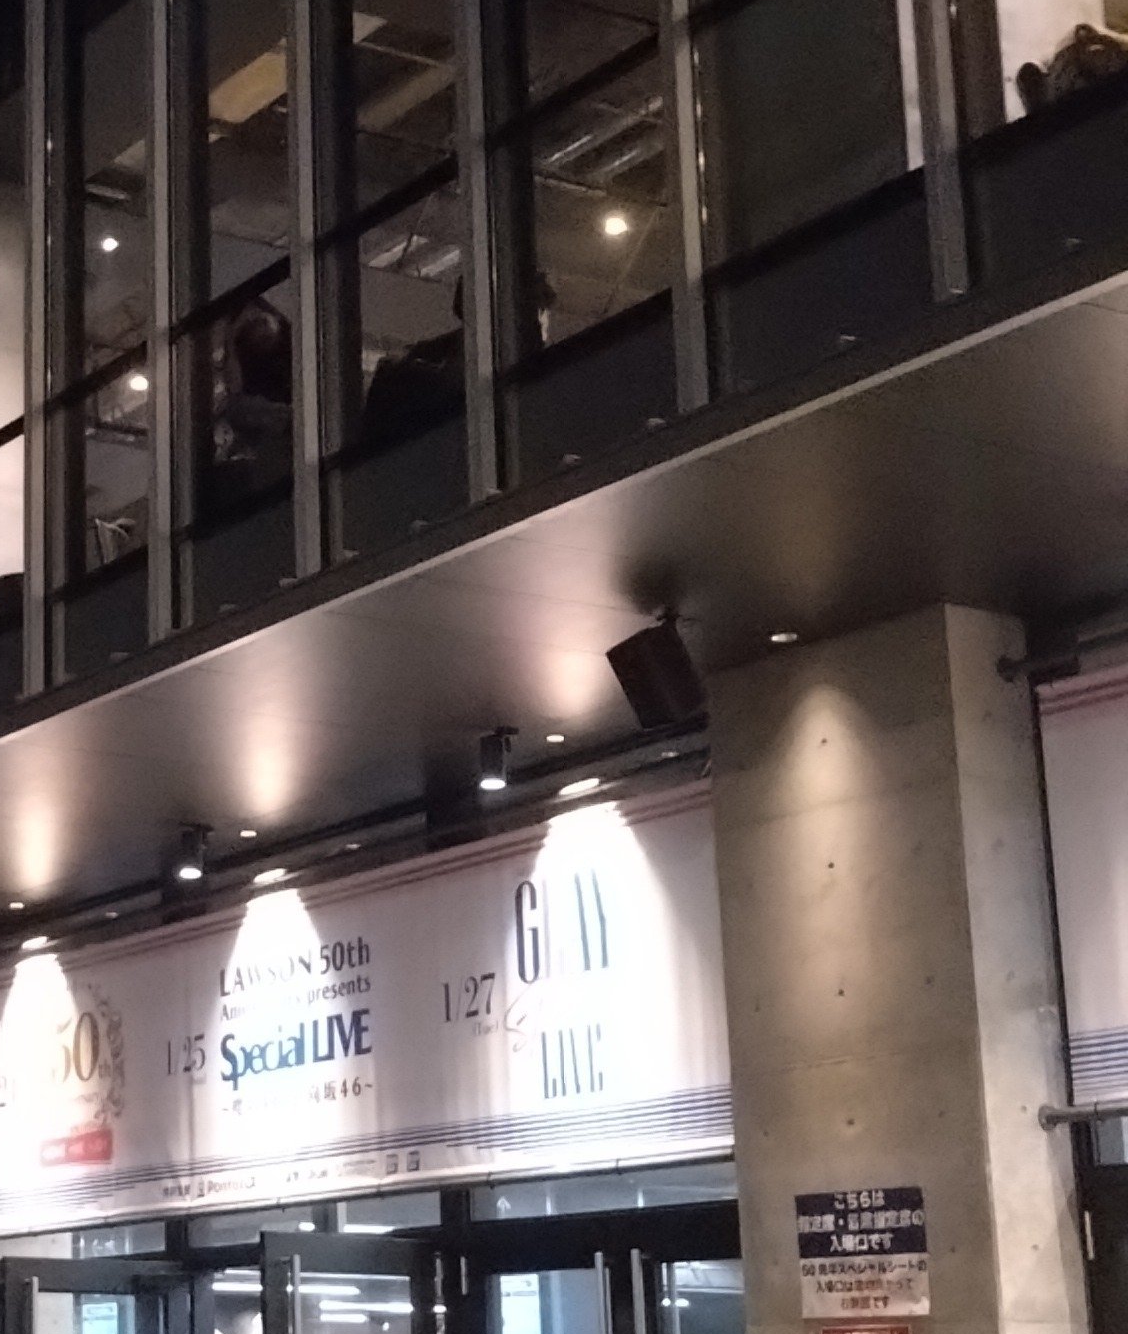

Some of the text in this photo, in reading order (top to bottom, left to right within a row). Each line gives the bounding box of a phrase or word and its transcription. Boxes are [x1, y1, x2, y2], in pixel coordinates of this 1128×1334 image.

[321, 936, 371, 975] 50th
[308, 974, 372, 1005] presents
[443, 972, 496, 1023] 1/27
[220, 1024, 305, 1092] Special
[313, 1007, 373, 1064] LIVE
